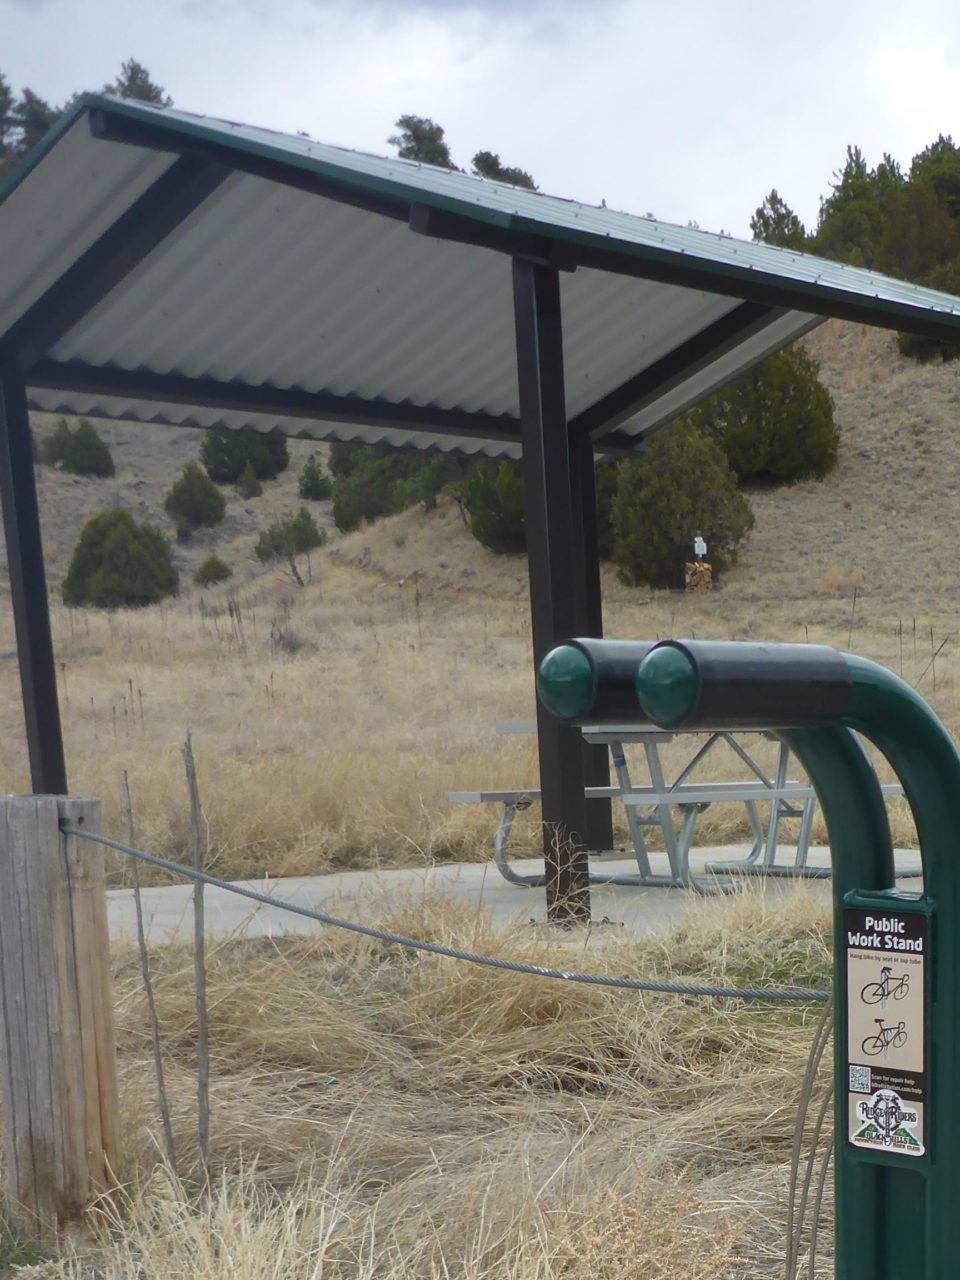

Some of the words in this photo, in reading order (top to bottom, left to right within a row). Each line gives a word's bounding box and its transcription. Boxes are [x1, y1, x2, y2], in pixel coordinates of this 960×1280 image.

[865, 916, 905, 933] Public
[847, 931, 882, 948] Work
[884, 934, 923, 951] Stand
[859, 1102, 885, 1120] RIDGE
[889, 1106, 917, 1122] RIDERS
[866, 1131, 885, 1141] BLACK
[890, 1135, 908, 1144] HILLS
